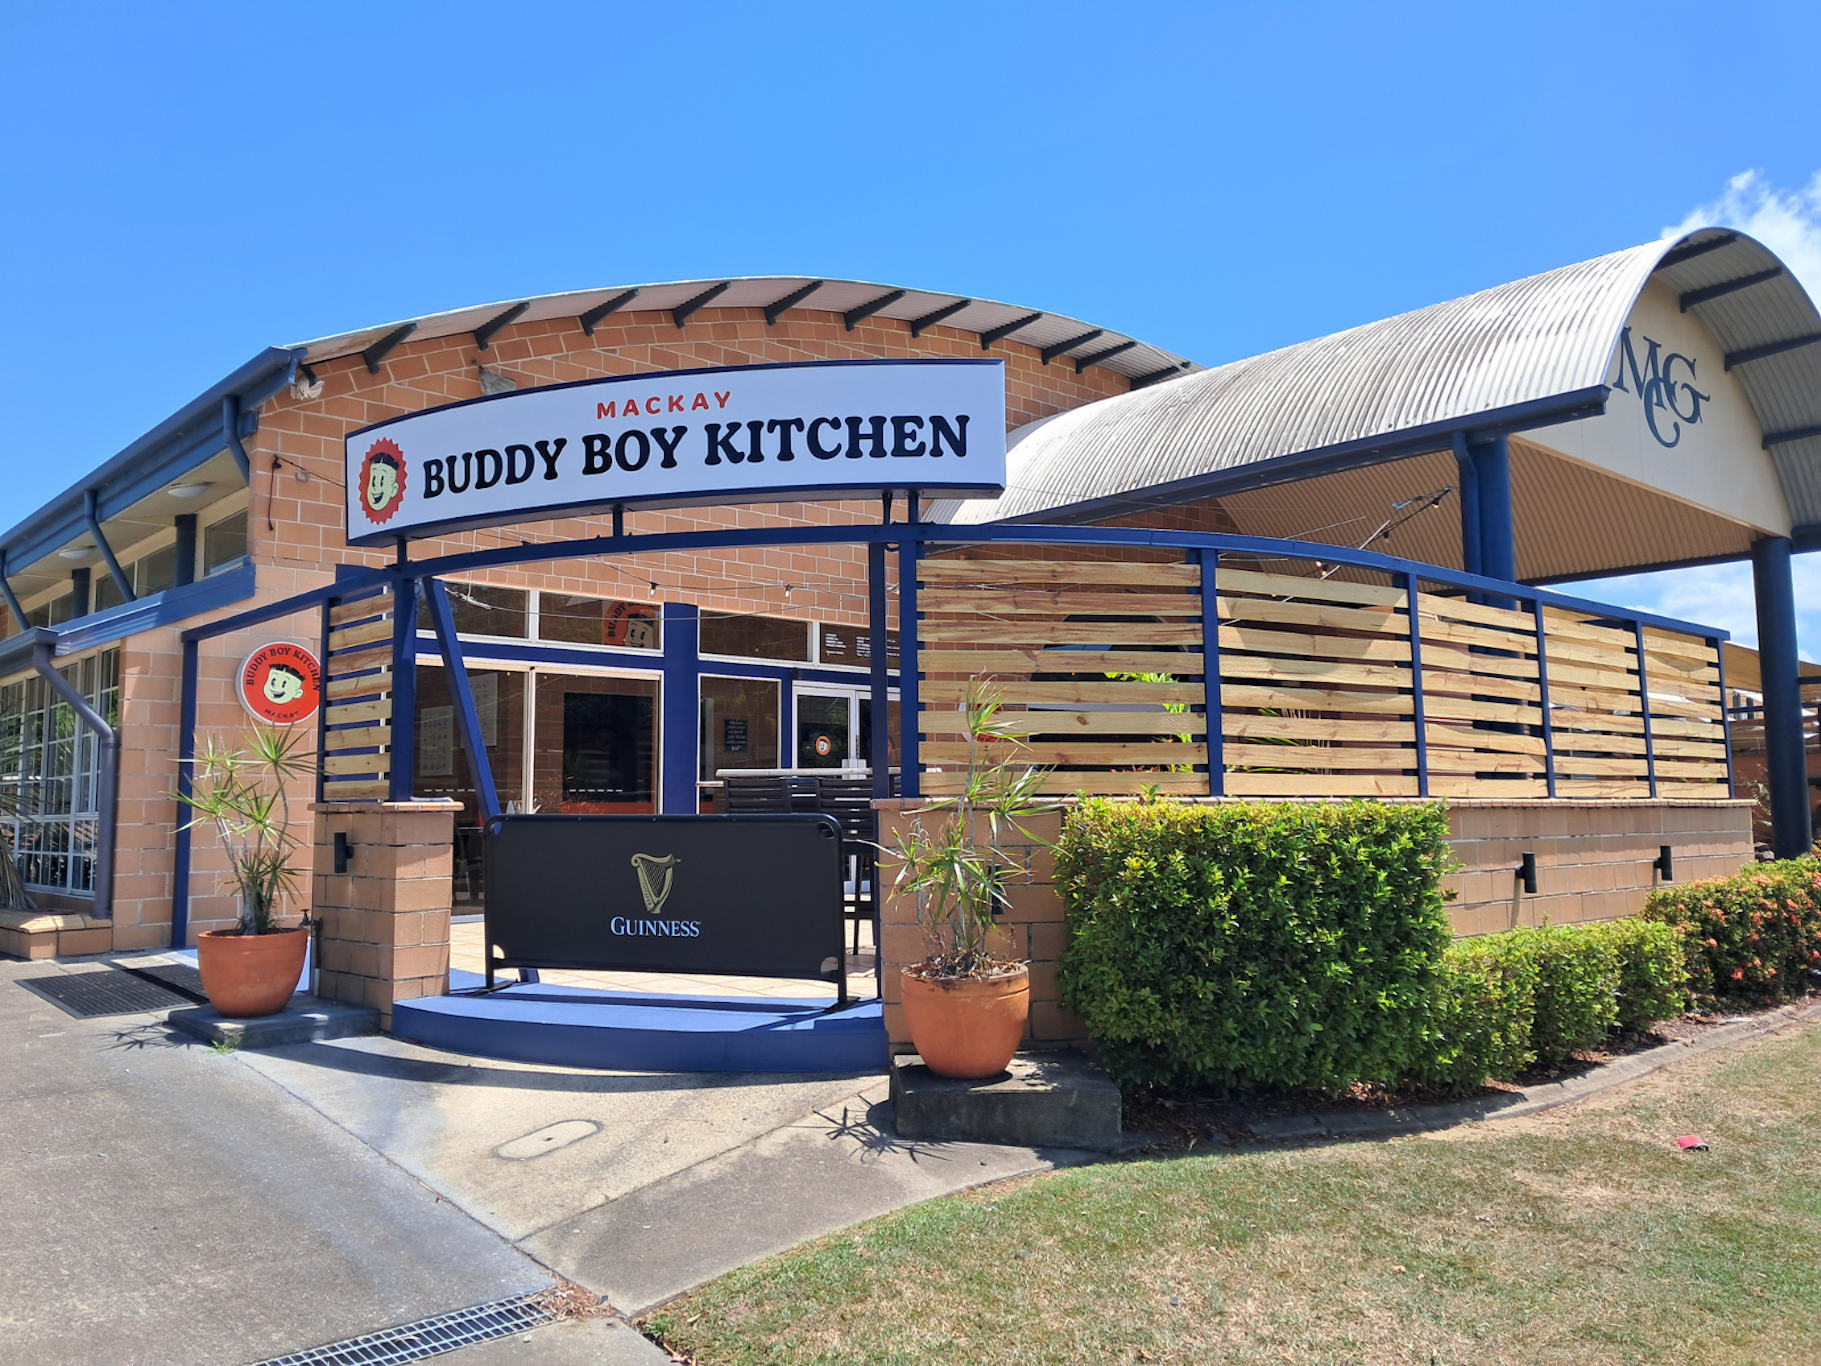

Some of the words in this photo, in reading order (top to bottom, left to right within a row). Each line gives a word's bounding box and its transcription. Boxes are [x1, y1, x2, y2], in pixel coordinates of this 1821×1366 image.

[597, 391, 732, 420] MACKAY
[423, 437, 568, 498] BUDDY
[581, 425, 688, 476] BOY
[704, 414, 970, 465] KITCHEN
[246, 652, 267, 686] BUDDY
[269, 647, 291, 657] BOY
[264, 708, 299, 719] MACKAY
[610, 915, 701, 938] GUINNESS
